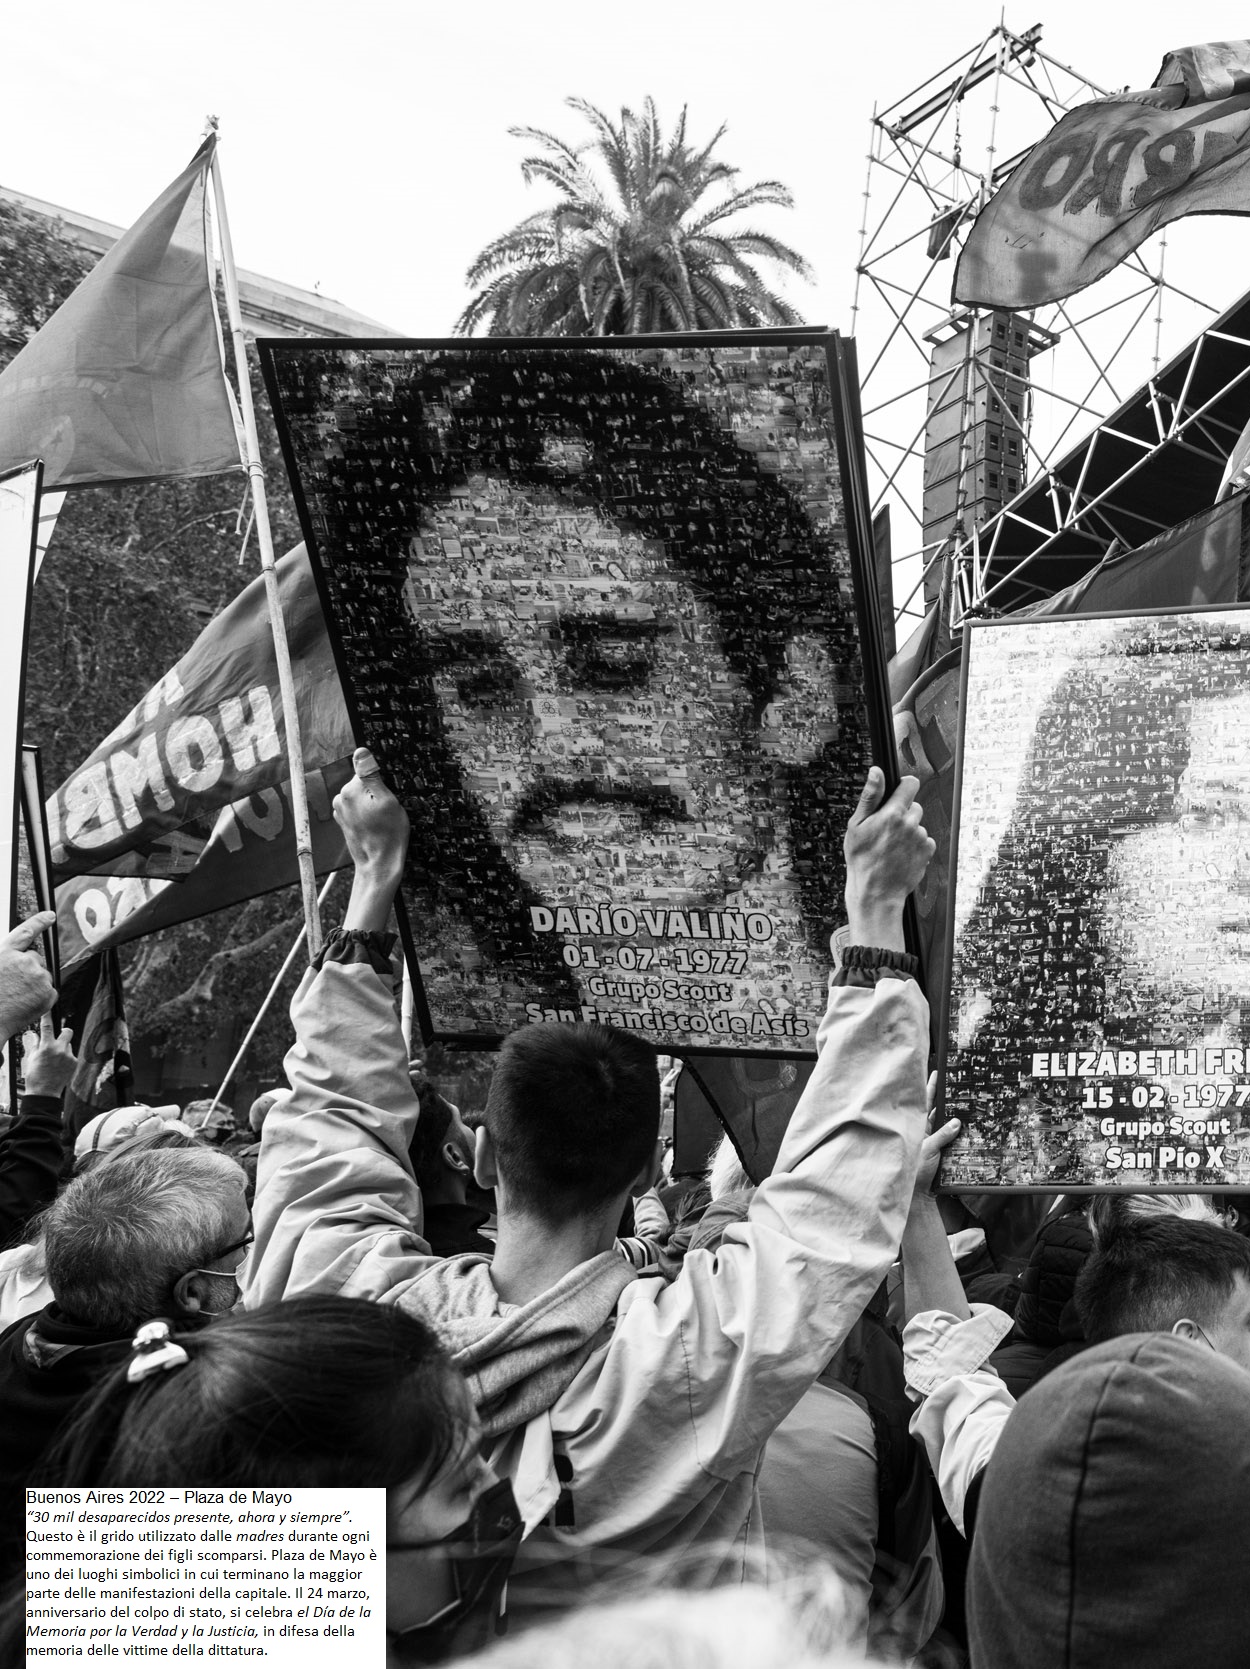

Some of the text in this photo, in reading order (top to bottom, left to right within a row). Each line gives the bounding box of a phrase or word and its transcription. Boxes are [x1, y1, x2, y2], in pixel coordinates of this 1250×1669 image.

[529, 903, 773, 941] DARÍO VALIÑO
[563, 944, 600, 969] 01
[616, 946, 654, 971] 07
[674, 949, 748, 974] 1977
[589, 977, 732, 1003] Grupo Scout
[525, 1003, 809, 1037] San Francisco de Asís
[1031, 1048, 1198, 1078] ELIZABETH
[1082, 1086, 1114, 1109] 15
[1131, 1085, 1166, 1108] 02
[1100, 1116, 1231, 1139] Grupo Scout
[1105, 1145, 1226, 1170] San Pío X
